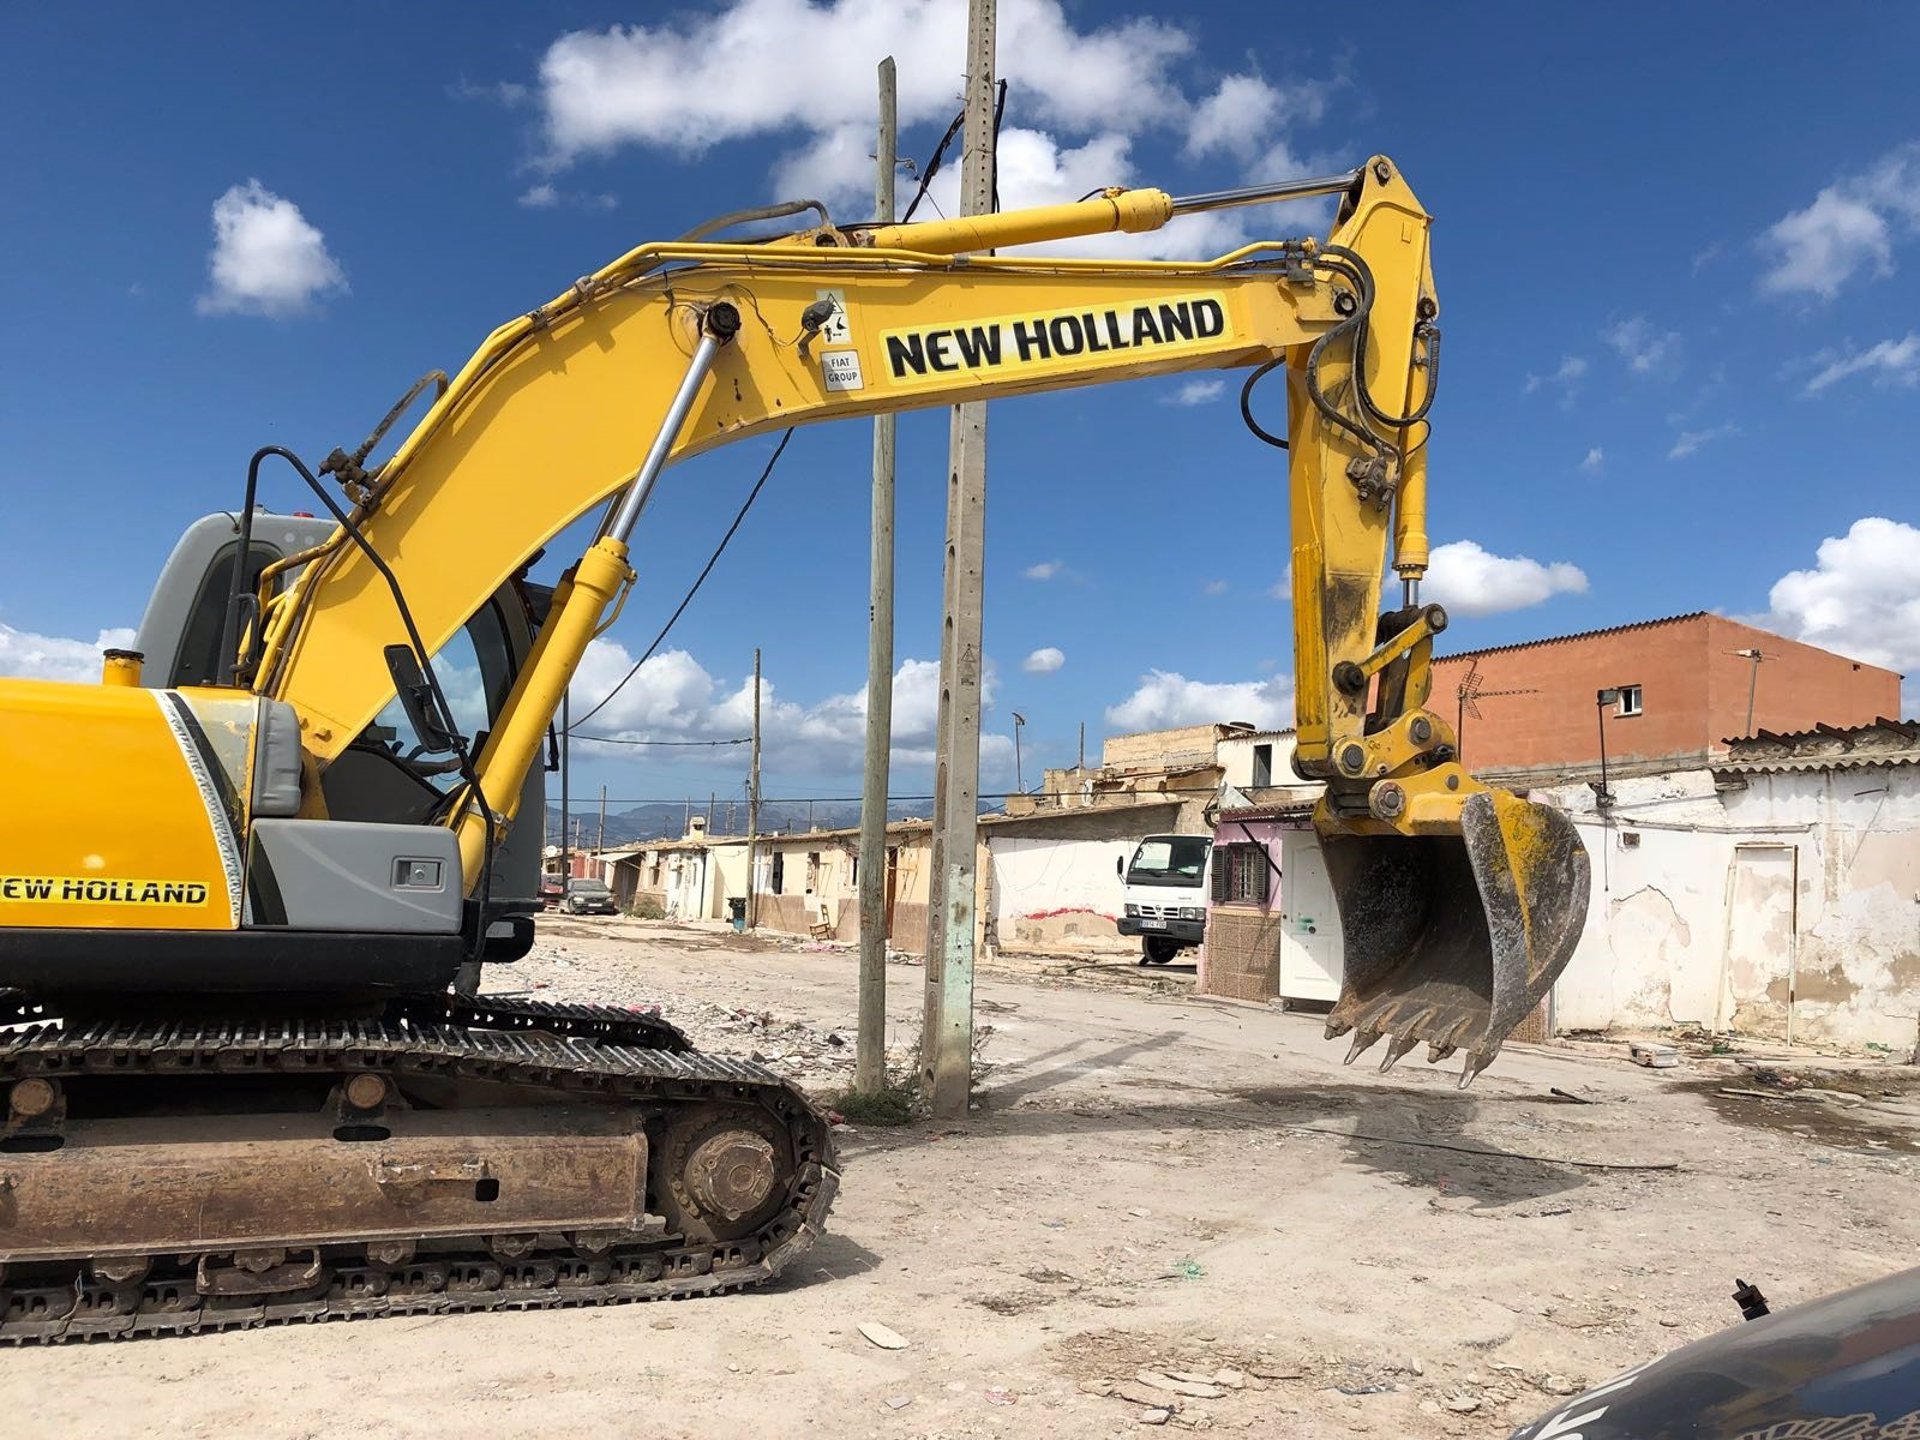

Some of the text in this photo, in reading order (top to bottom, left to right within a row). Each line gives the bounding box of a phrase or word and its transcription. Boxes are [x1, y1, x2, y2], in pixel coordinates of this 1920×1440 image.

[886, 298, 1224, 378] NEW HOLLAND
[831, 358, 850, 368] FIAT
[828, 371, 858, 383] GROUP
[0, 878, 206, 904] EW HOLLAND
